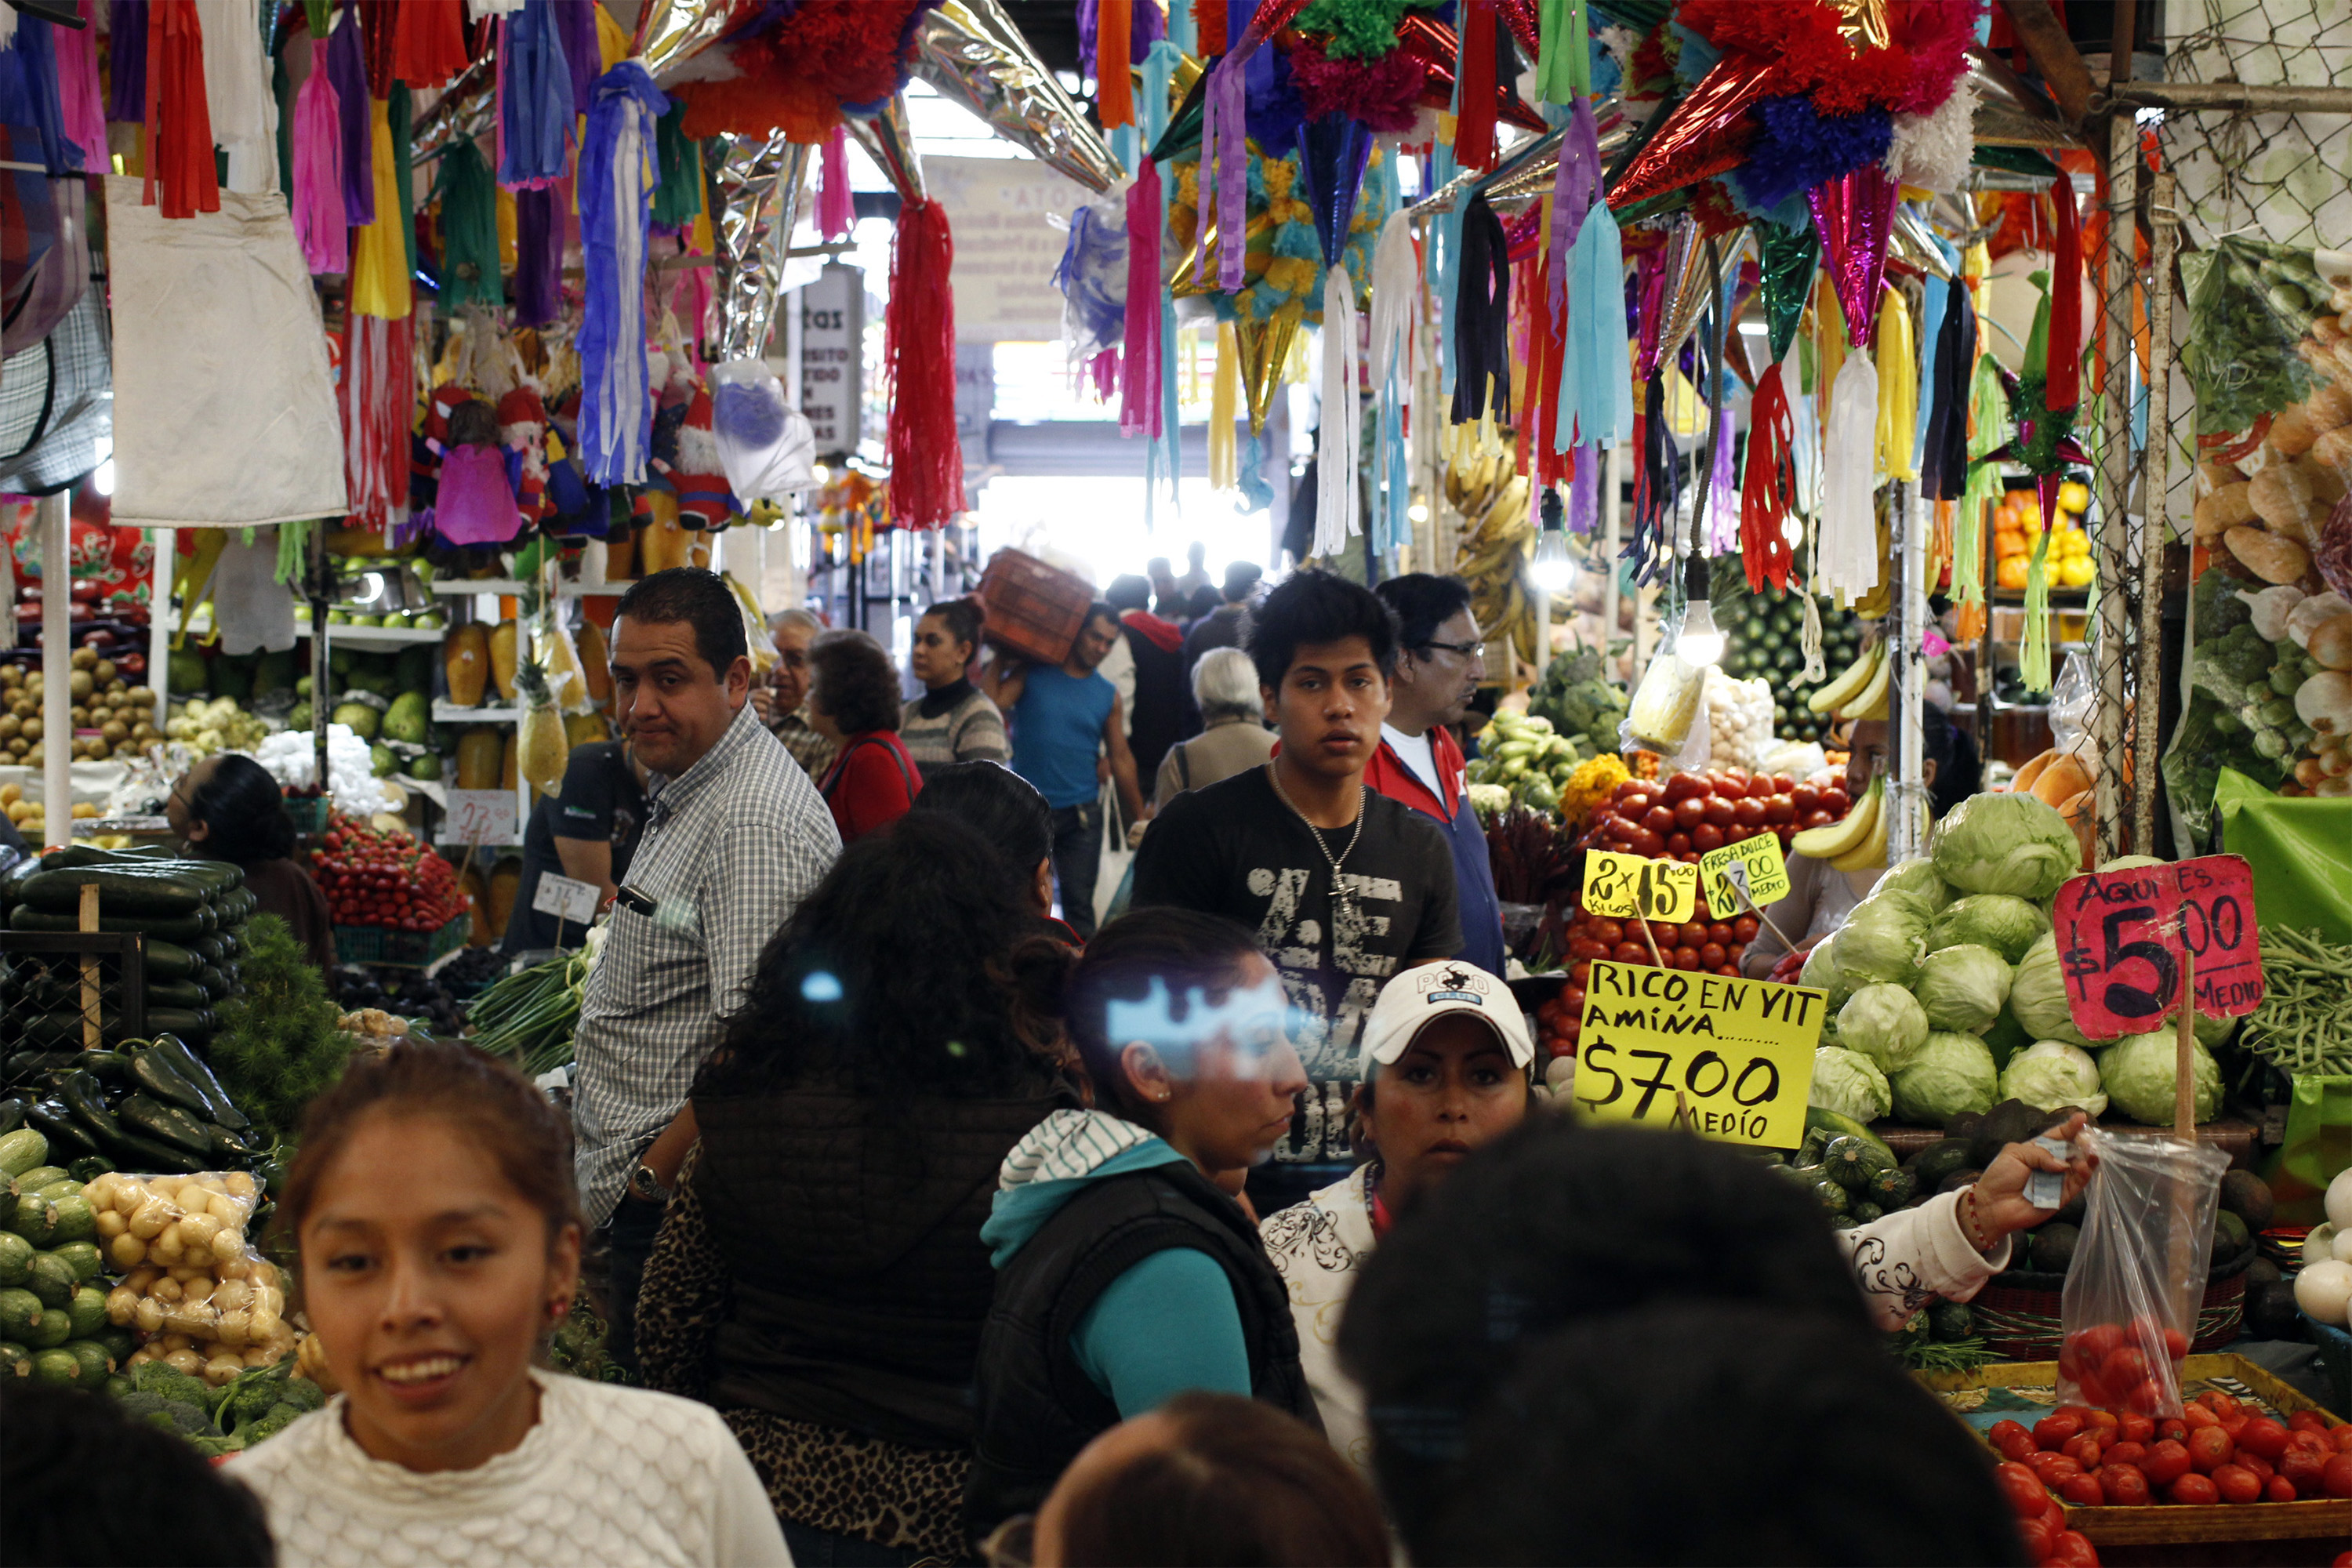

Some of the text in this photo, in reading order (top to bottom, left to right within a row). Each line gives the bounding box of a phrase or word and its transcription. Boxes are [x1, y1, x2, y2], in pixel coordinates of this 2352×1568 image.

[1703, 834, 1773, 872] FRESA DULCE
[1751, 879, 1786, 898] MEDIO
[2076, 876, 2161, 912] AQUI
[1700, 979, 1749, 1012] EN
[2194, 977, 2264, 1009] MEDIO
